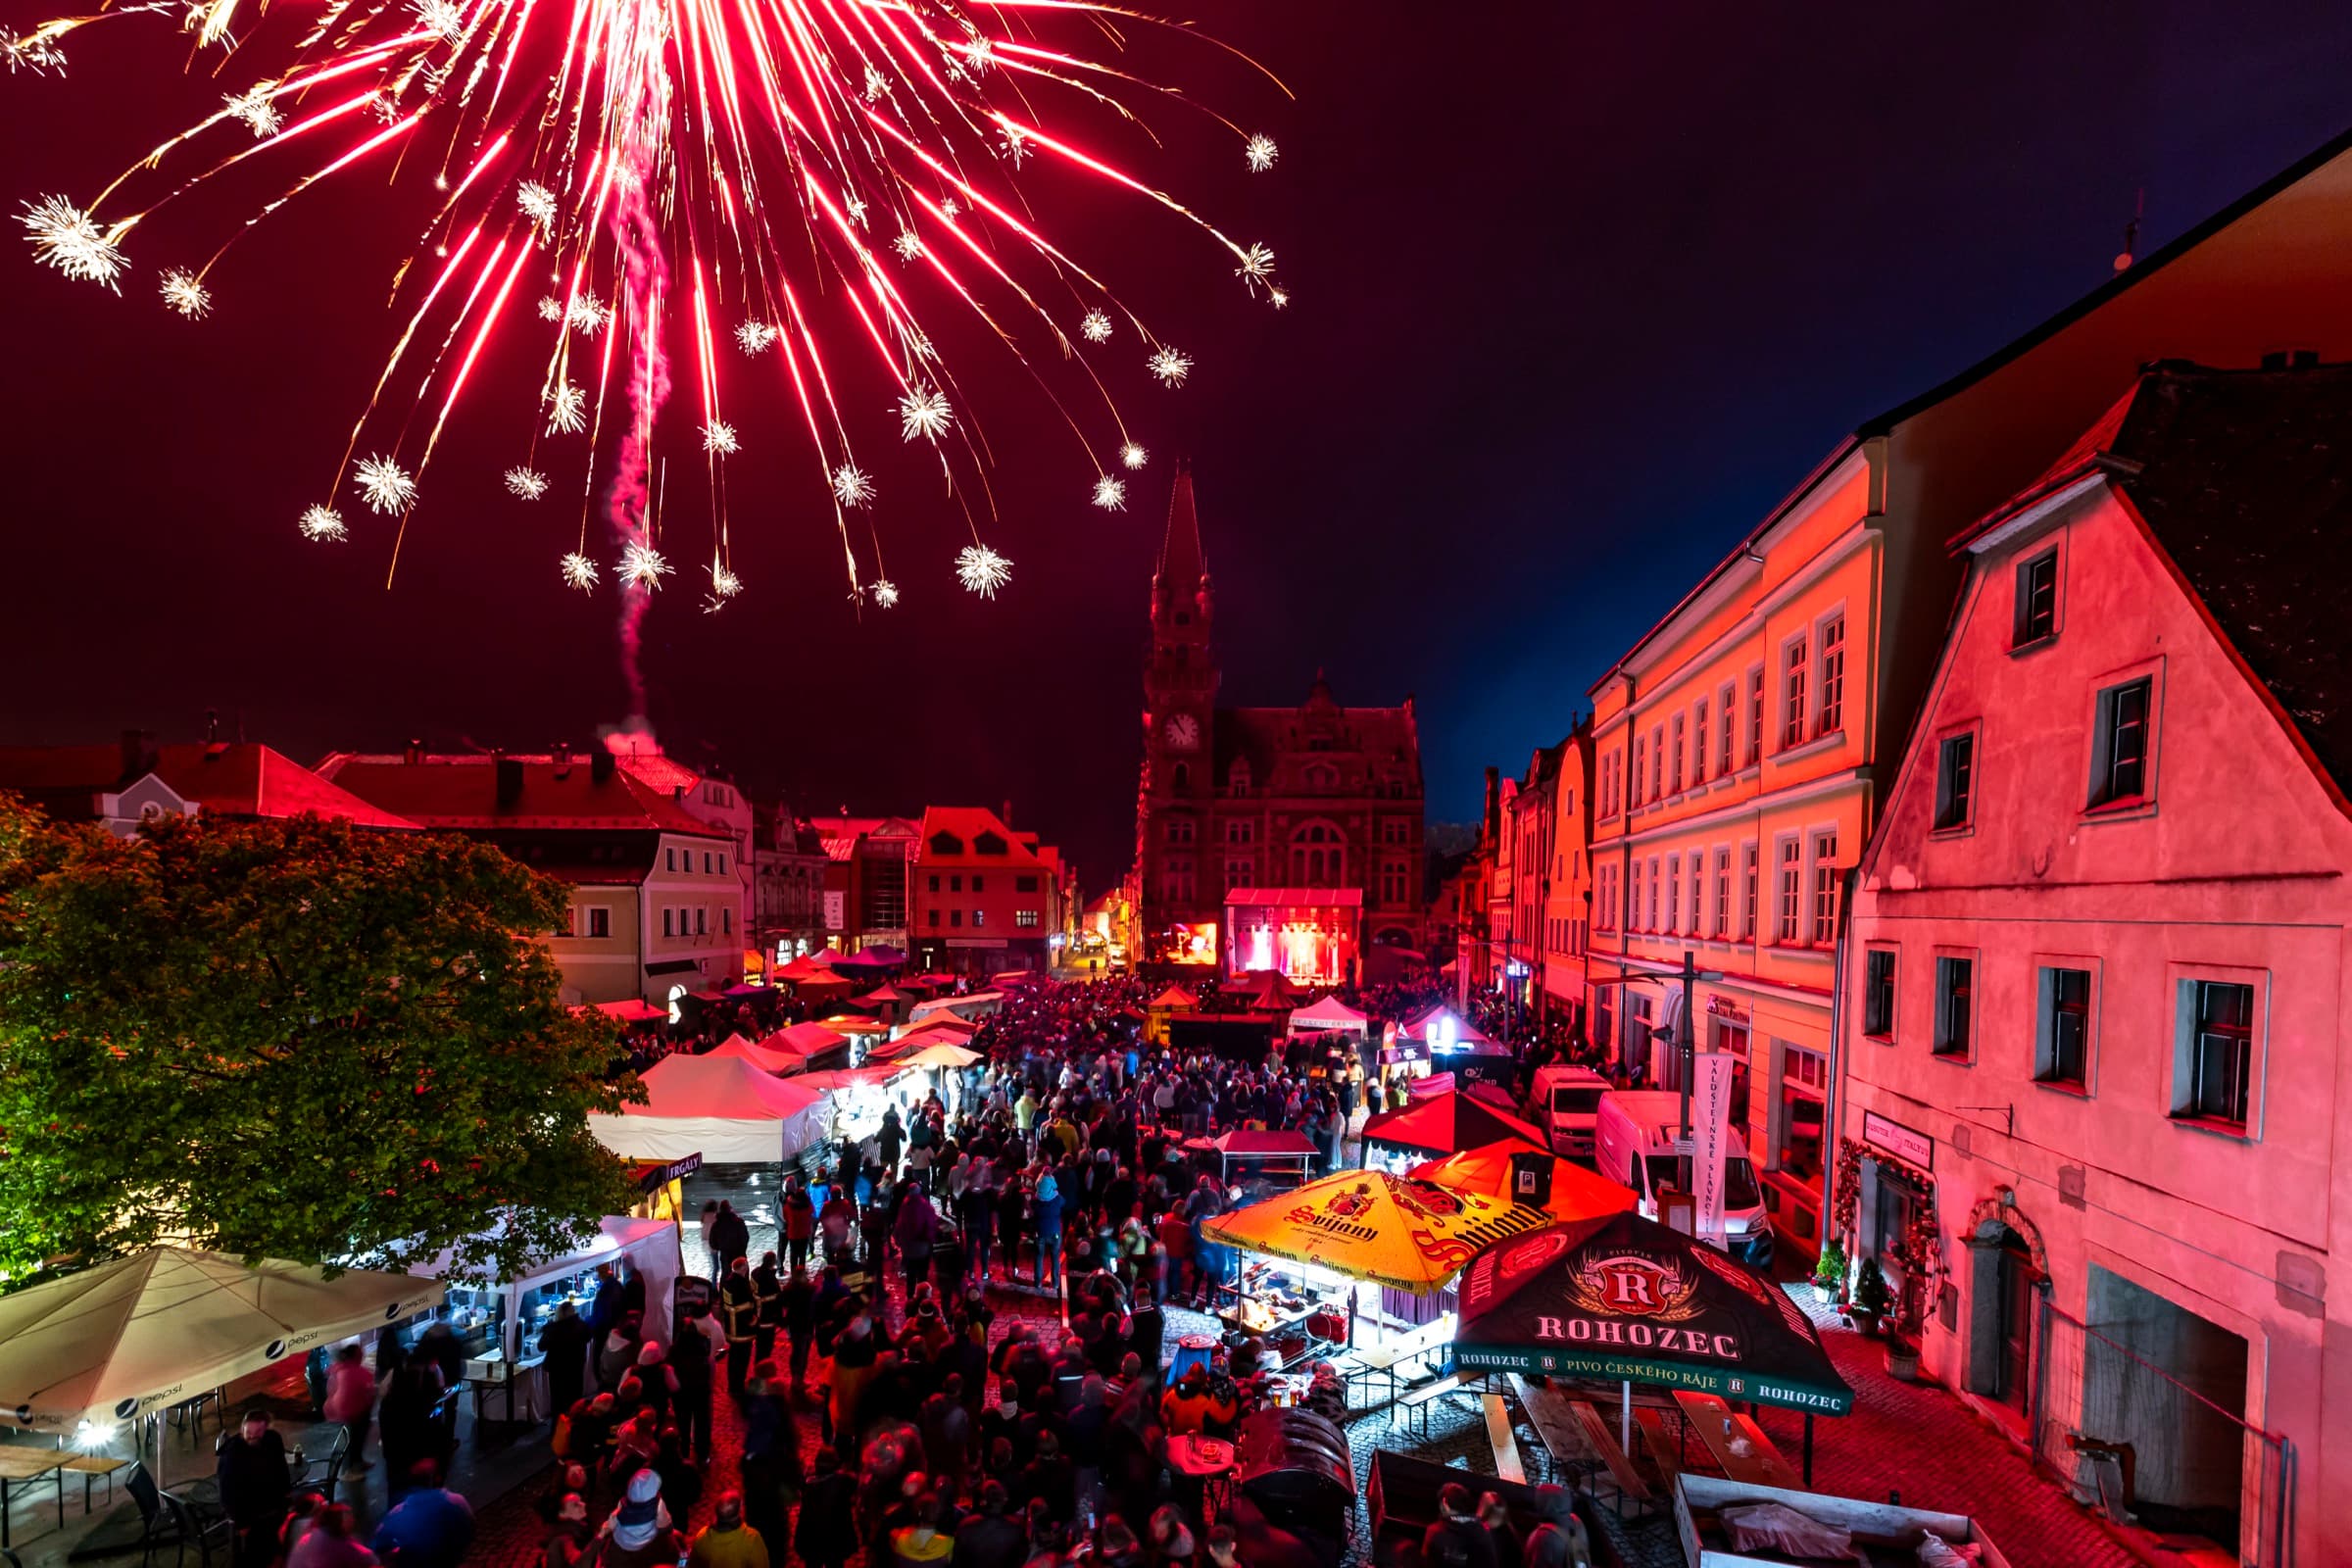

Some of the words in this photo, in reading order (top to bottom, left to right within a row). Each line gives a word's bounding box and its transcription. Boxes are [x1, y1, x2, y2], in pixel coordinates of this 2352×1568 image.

[1284, 1205, 1379, 1242] Svijany
[1612, 1273, 1654, 1304] R
[288, 1331, 318, 1348] pepsi
[1537, 1316, 1739, 1358] ROHOZEC
[142, 1384, 183, 1408] pepsi
[1460, 1353, 1530, 1368] ROHOZEC
[1567, 1360, 1601, 1372] PIVO
[1605, 1361, 1678, 1381] ČESKÉHO
[1683, 1372, 1717, 1388] RÁJE
[1758, 1385, 1842, 1410] ROHOZEC
